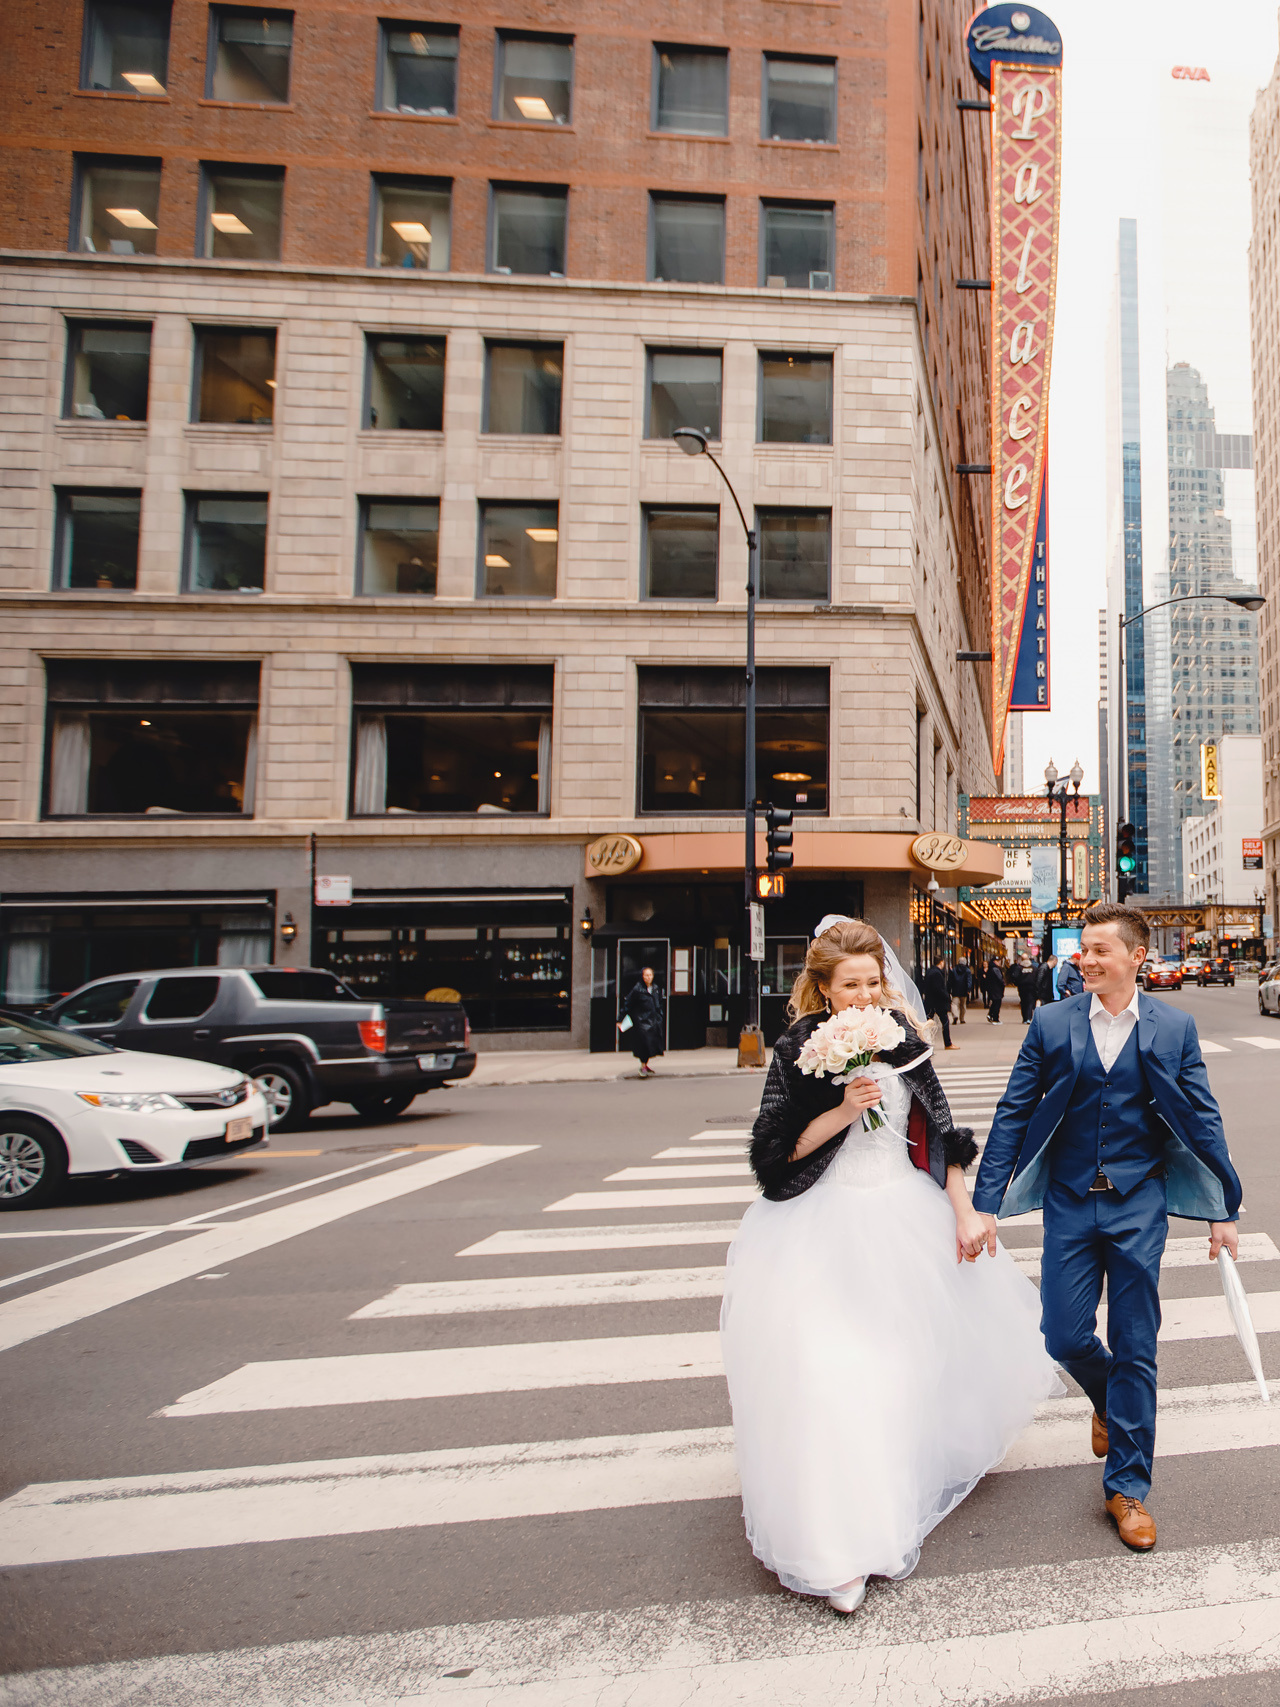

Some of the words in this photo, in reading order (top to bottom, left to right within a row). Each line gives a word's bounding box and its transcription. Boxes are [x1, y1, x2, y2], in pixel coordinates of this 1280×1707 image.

[971, 25, 1060, 55] Cadillac
[1171, 65, 1211, 82] CNA
[1004, 84, 1051, 510] Palace
[1035, 541, 1046, 703] THEATRE
[1206, 746, 1216, 796] PARK
[993, 803, 1032, 815] Cadillac
[1015, 825, 1045, 834] THEATRE
[920, 837, 962, 863] 312
